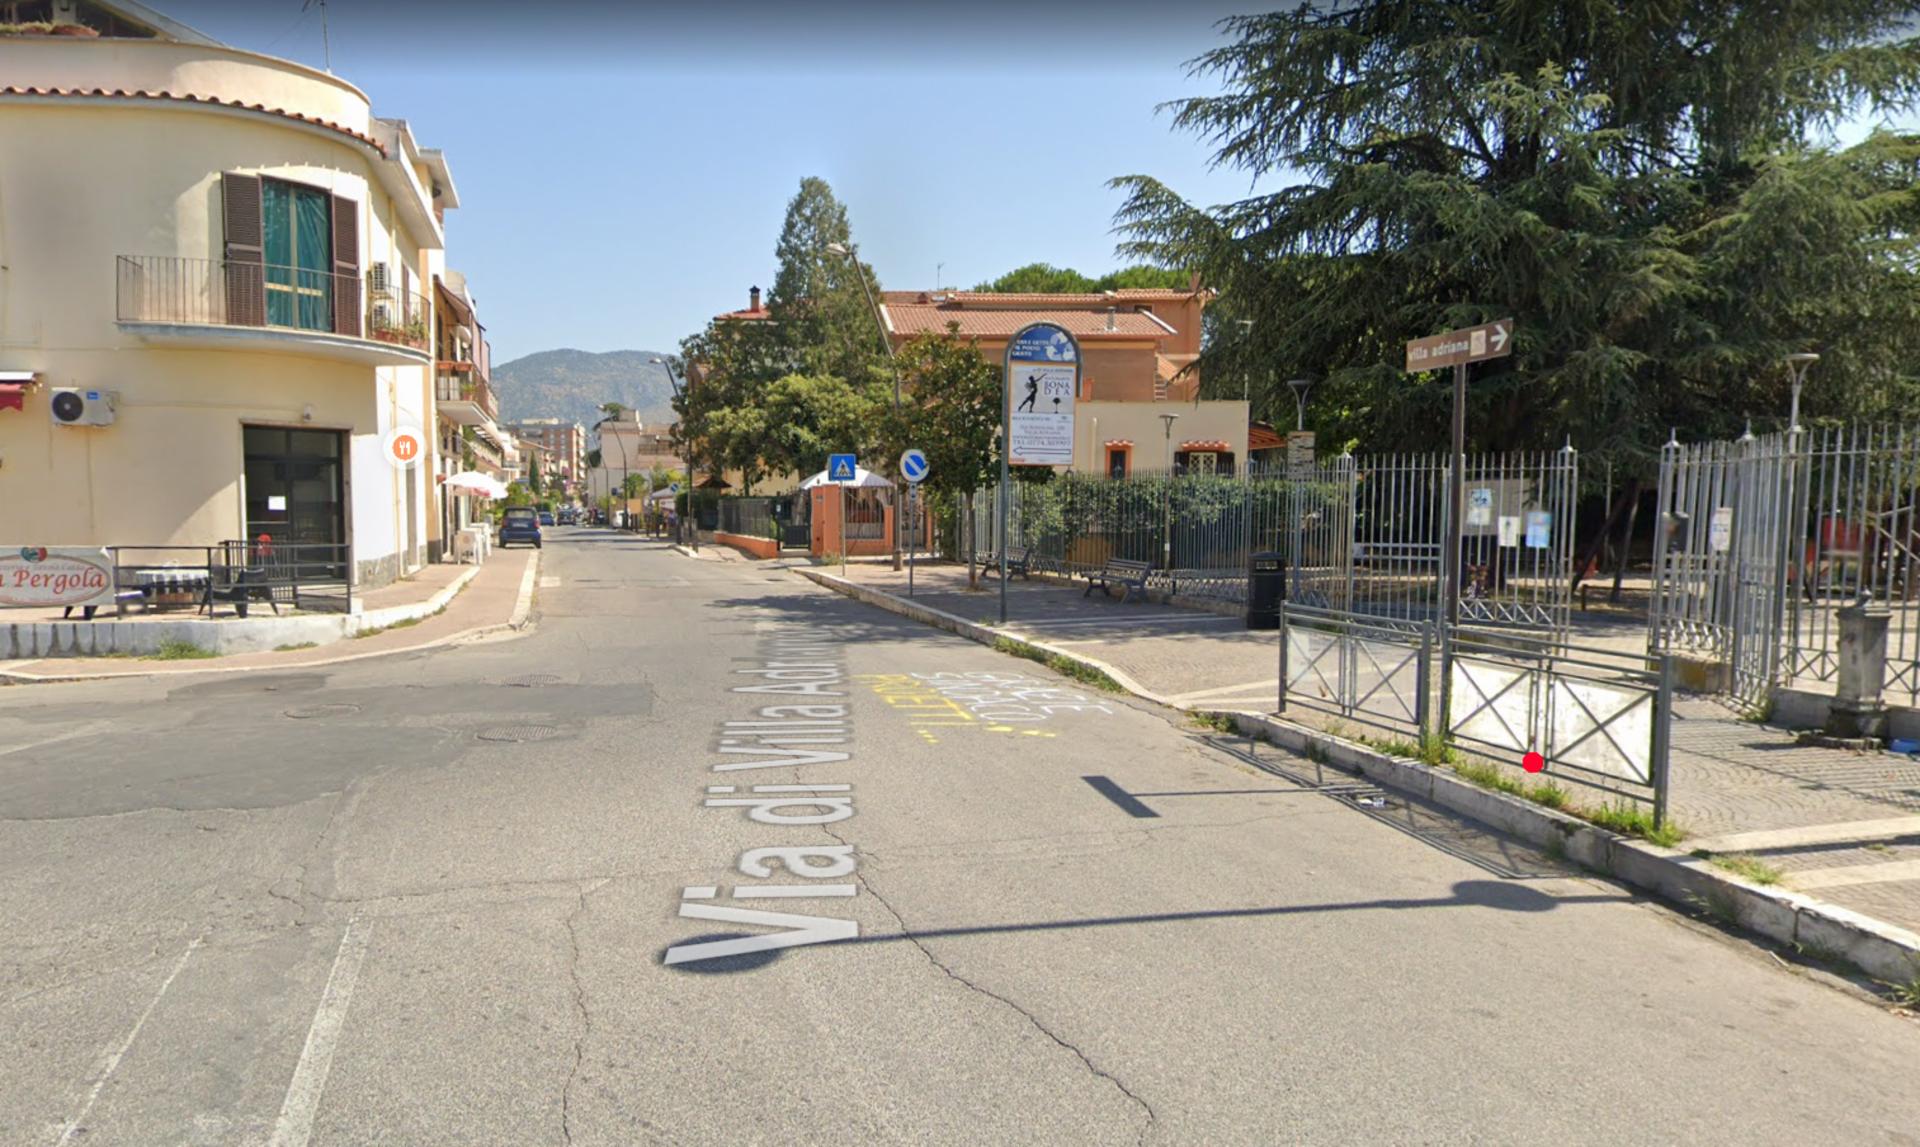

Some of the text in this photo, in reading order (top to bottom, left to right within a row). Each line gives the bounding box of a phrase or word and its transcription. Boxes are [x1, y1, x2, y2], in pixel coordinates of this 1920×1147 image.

[1408, 341, 1469, 361] villa adriana
[13, 566, 104, 595] Pergola
